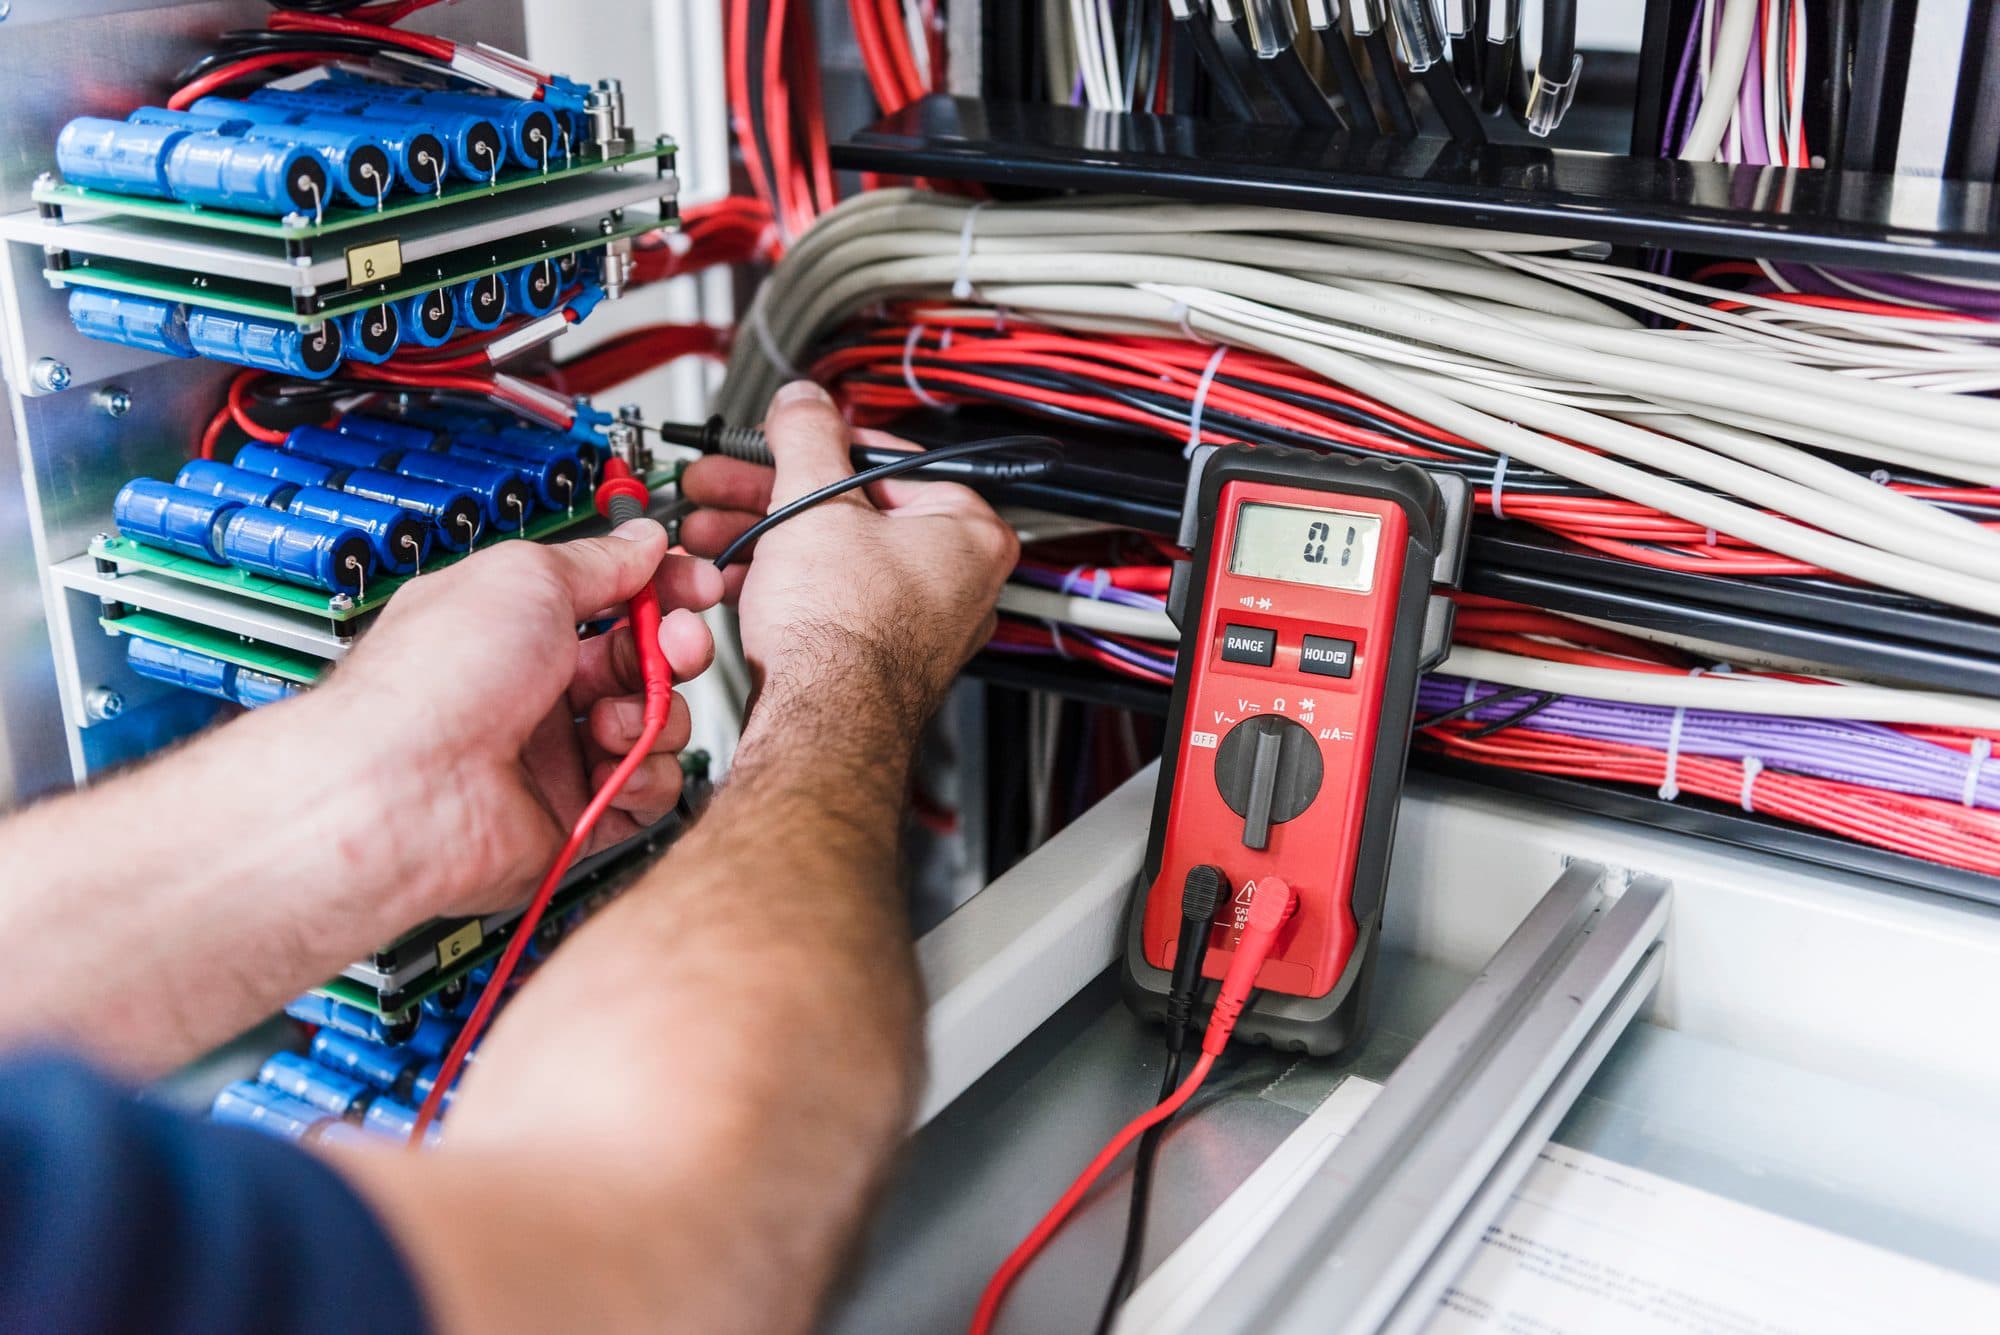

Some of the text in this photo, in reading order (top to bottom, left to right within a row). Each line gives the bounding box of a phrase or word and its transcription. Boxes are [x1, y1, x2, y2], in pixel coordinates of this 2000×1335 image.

[1303, 522, 1355, 566] 0.1
[1227, 637, 1264, 653] RANGE
[1193, 733, 1215, 745] OFF
[1236, 914, 1248, 922] MA
